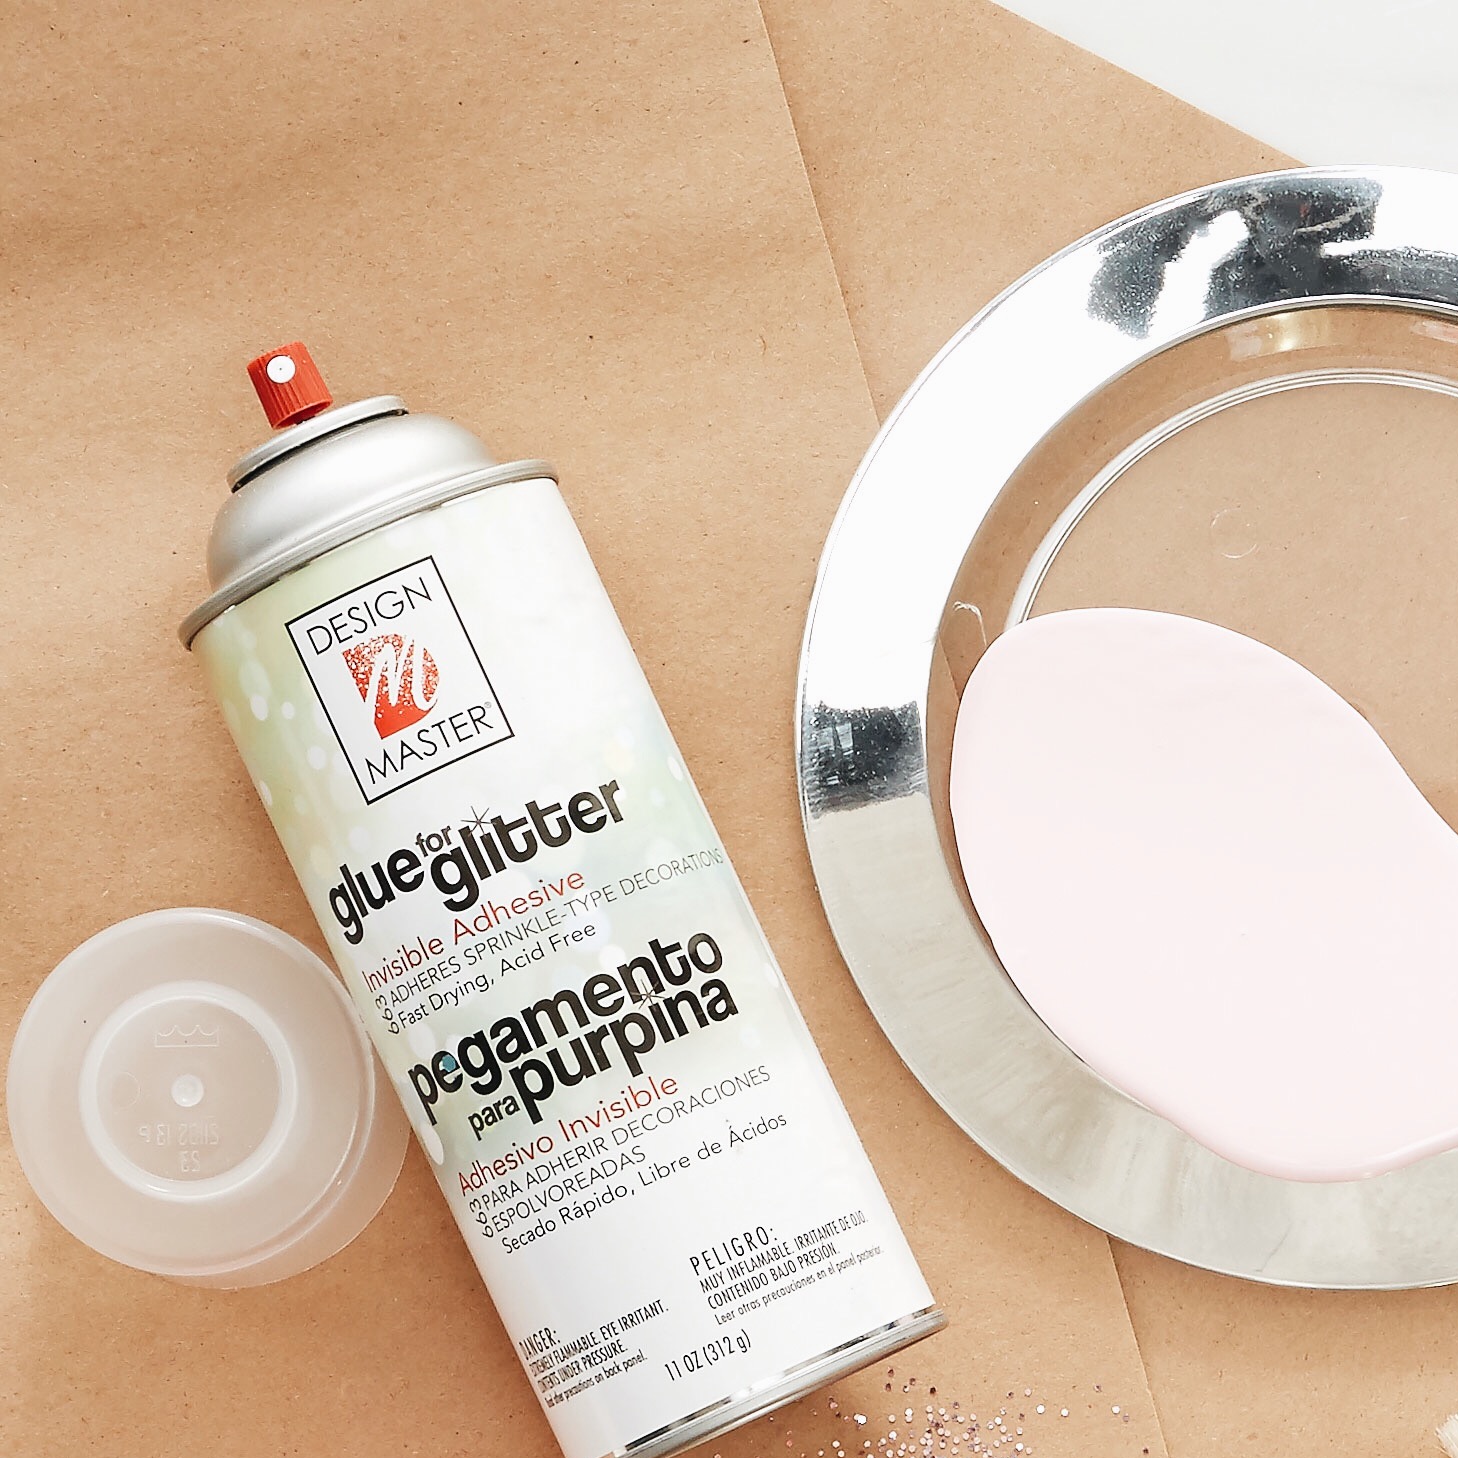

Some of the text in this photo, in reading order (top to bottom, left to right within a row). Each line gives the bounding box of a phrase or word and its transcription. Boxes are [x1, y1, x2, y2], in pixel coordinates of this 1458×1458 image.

[307, 577, 432, 655] DESIGN
[327, 779, 623, 944] glue for glitter
[362, 871, 585, 993] Invisible Adhesive
[391, 847, 723, 1007] ADHERES SPRINKLE-TYPE DECORATIONS
[400, 924, 596, 1036] Fast Drying, Acid Free
[408, 933, 723, 1125] pegamento
[467, 980, 738, 1141] para purpina
[458, 1076, 678, 1197] Adhesivo Invisible
[481, 1065, 771, 1211] PARA ADHERIR DECORACIONES
[491, 1145, 647, 1234] ESPOLVOREADAS
[502, 1113, 787, 1254] Secado Rápido, Libre de Ácidos
[689, 1226, 778, 1276] PELIGRO:
[699, 1271, 725, 1294] MUY
[728, 1241, 795, 1281] INFLAMABLE.
[793, 1220, 840, 1251] IRRITANTE
[838, 1216, 852, 1231] DE
[707, 1242, 840, 1310] CONTENIDO BAJO PRESIÓN.
[714, 1308, 736, 1326] Leer
[737, 1299, 761, 1316] otras
[762, 1274, 816, 1308] precauciones
[816, 1269, 827, 1280] en
[828, 1262, 836, 1275] el
[836, 1252, 857, 1274] panel
[557, 1360, 583, 1383] UNDER
[581, 1339, 628, 1371] PRESSURE.
[599, 1321, 620, 1341] EYE
[617, 1299, 669, 1332] IRRITANT.
[603, 1361, 623, 1379] back
[622, 1349, 648, 1372] panel.
[664, 1359, 682, 1381] 11
